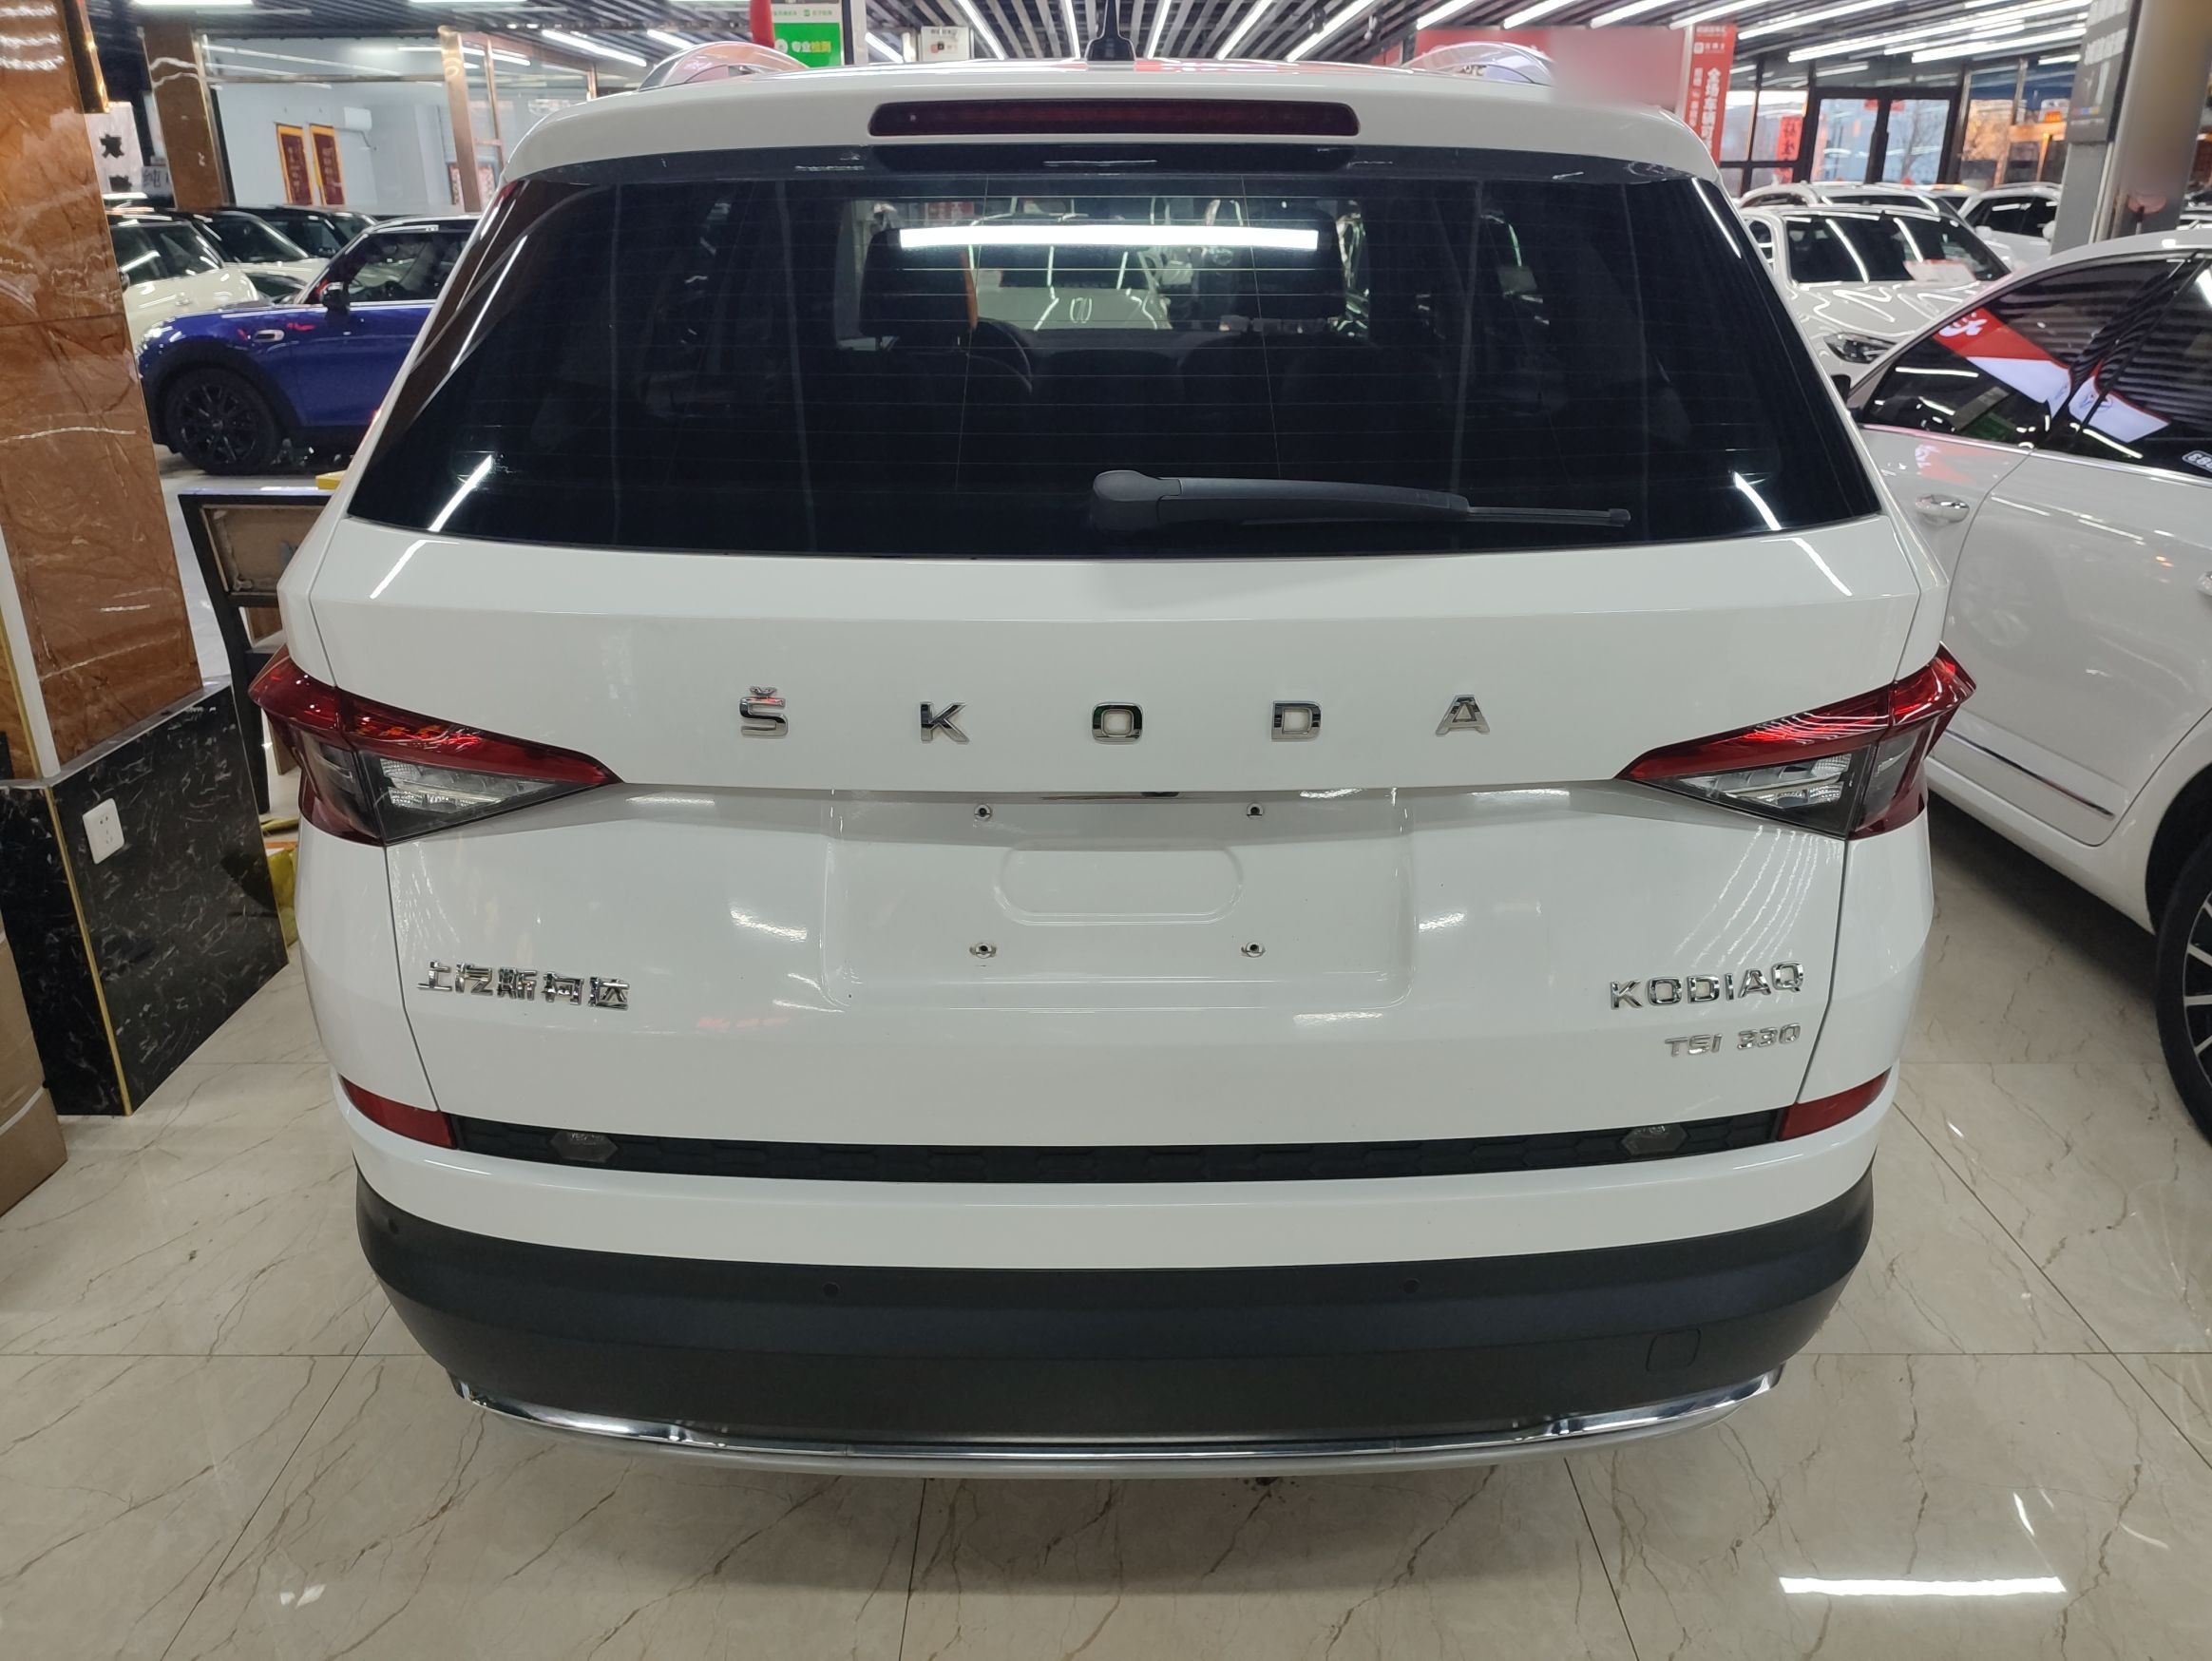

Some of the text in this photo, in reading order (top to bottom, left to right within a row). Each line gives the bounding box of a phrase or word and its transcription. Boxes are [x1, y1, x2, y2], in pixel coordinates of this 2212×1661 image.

[738, 685, 1491, 744] ŠKODA
[1610, 960, 1805, 1010] KODIAQ
[1664, 1022, 1802, 1058] TSI 330
